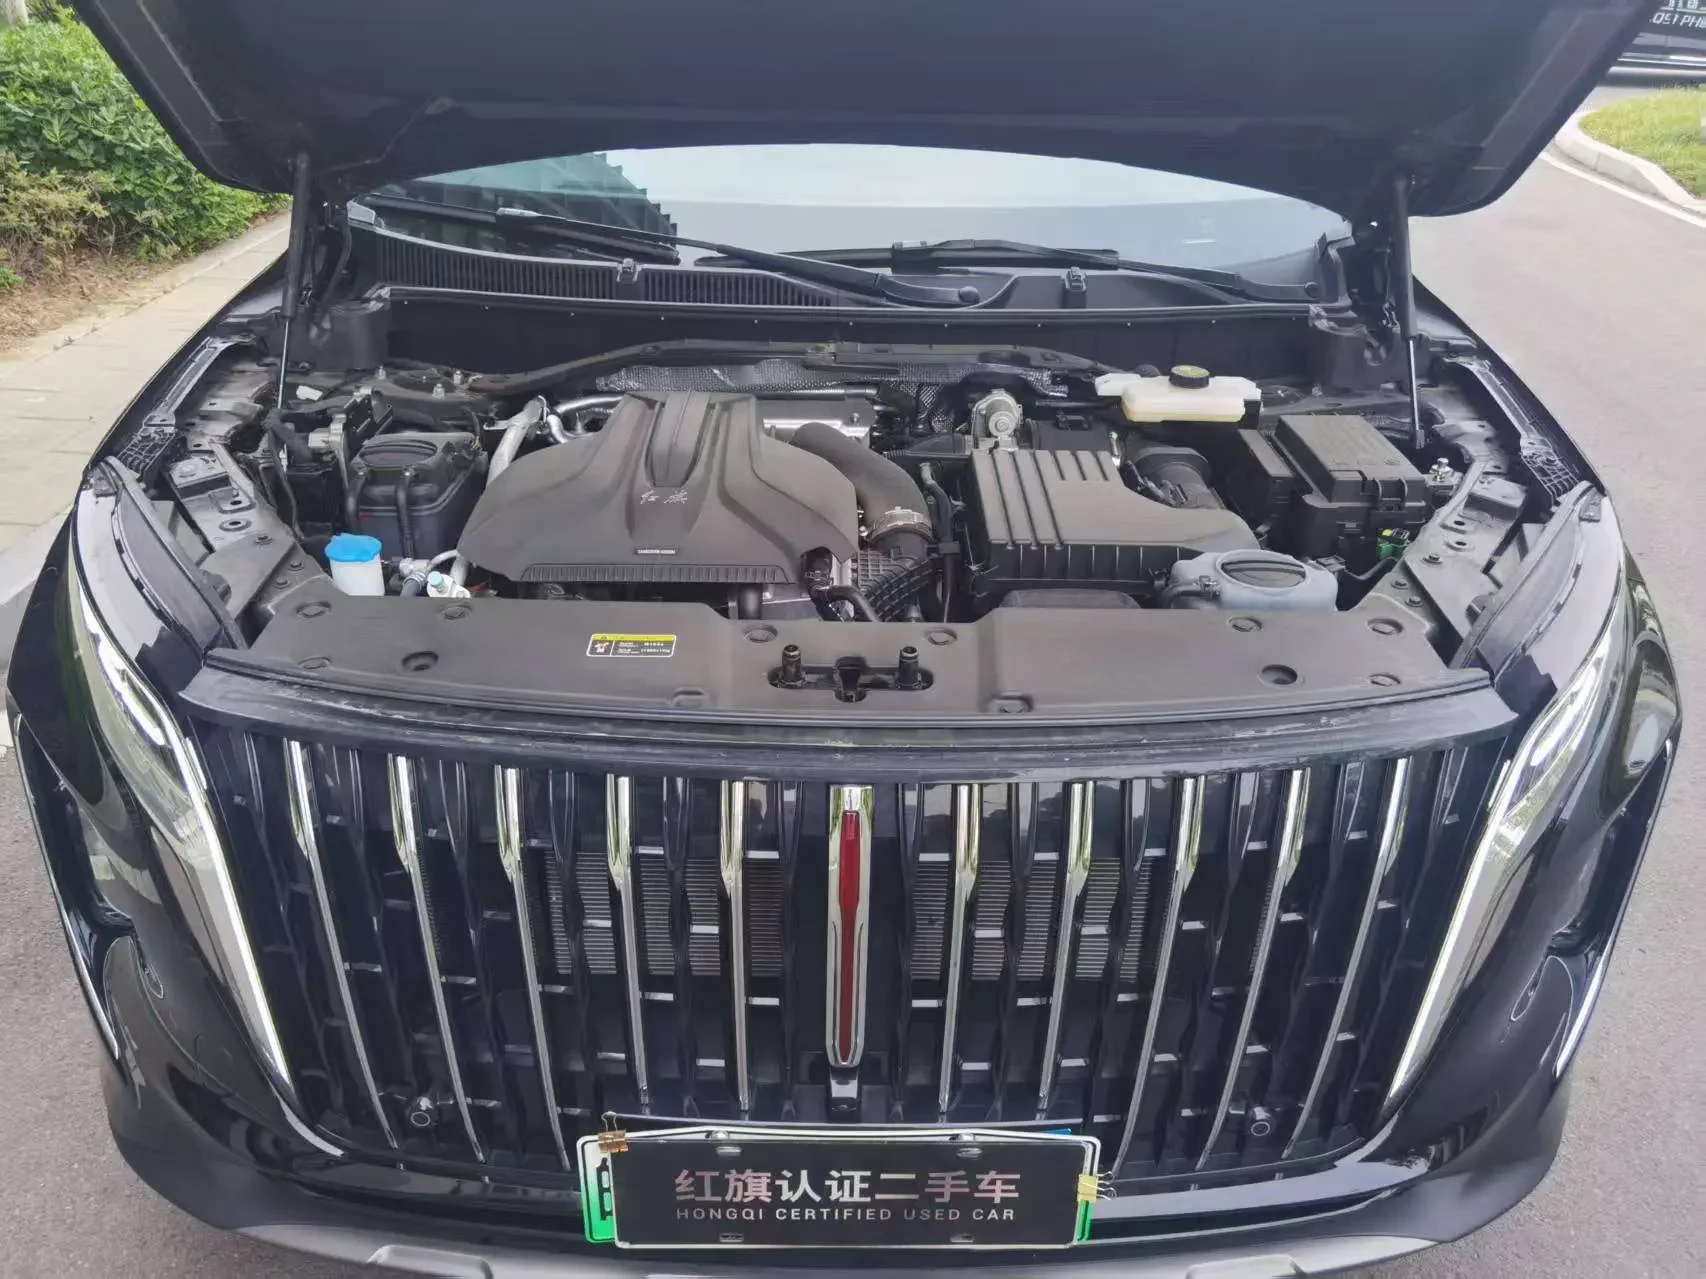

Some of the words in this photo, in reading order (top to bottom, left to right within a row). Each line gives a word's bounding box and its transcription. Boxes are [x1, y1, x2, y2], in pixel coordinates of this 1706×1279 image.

[674, 1168, 1021, 1204] 红旗认证二手车
[676, 1208, 764, 1221] HONGQI
[775, 1208, 892, 1221] CERTIFIED
[903, 1208, 961, 1221] USED
[972, 1208, 1016, 1221] CAR
